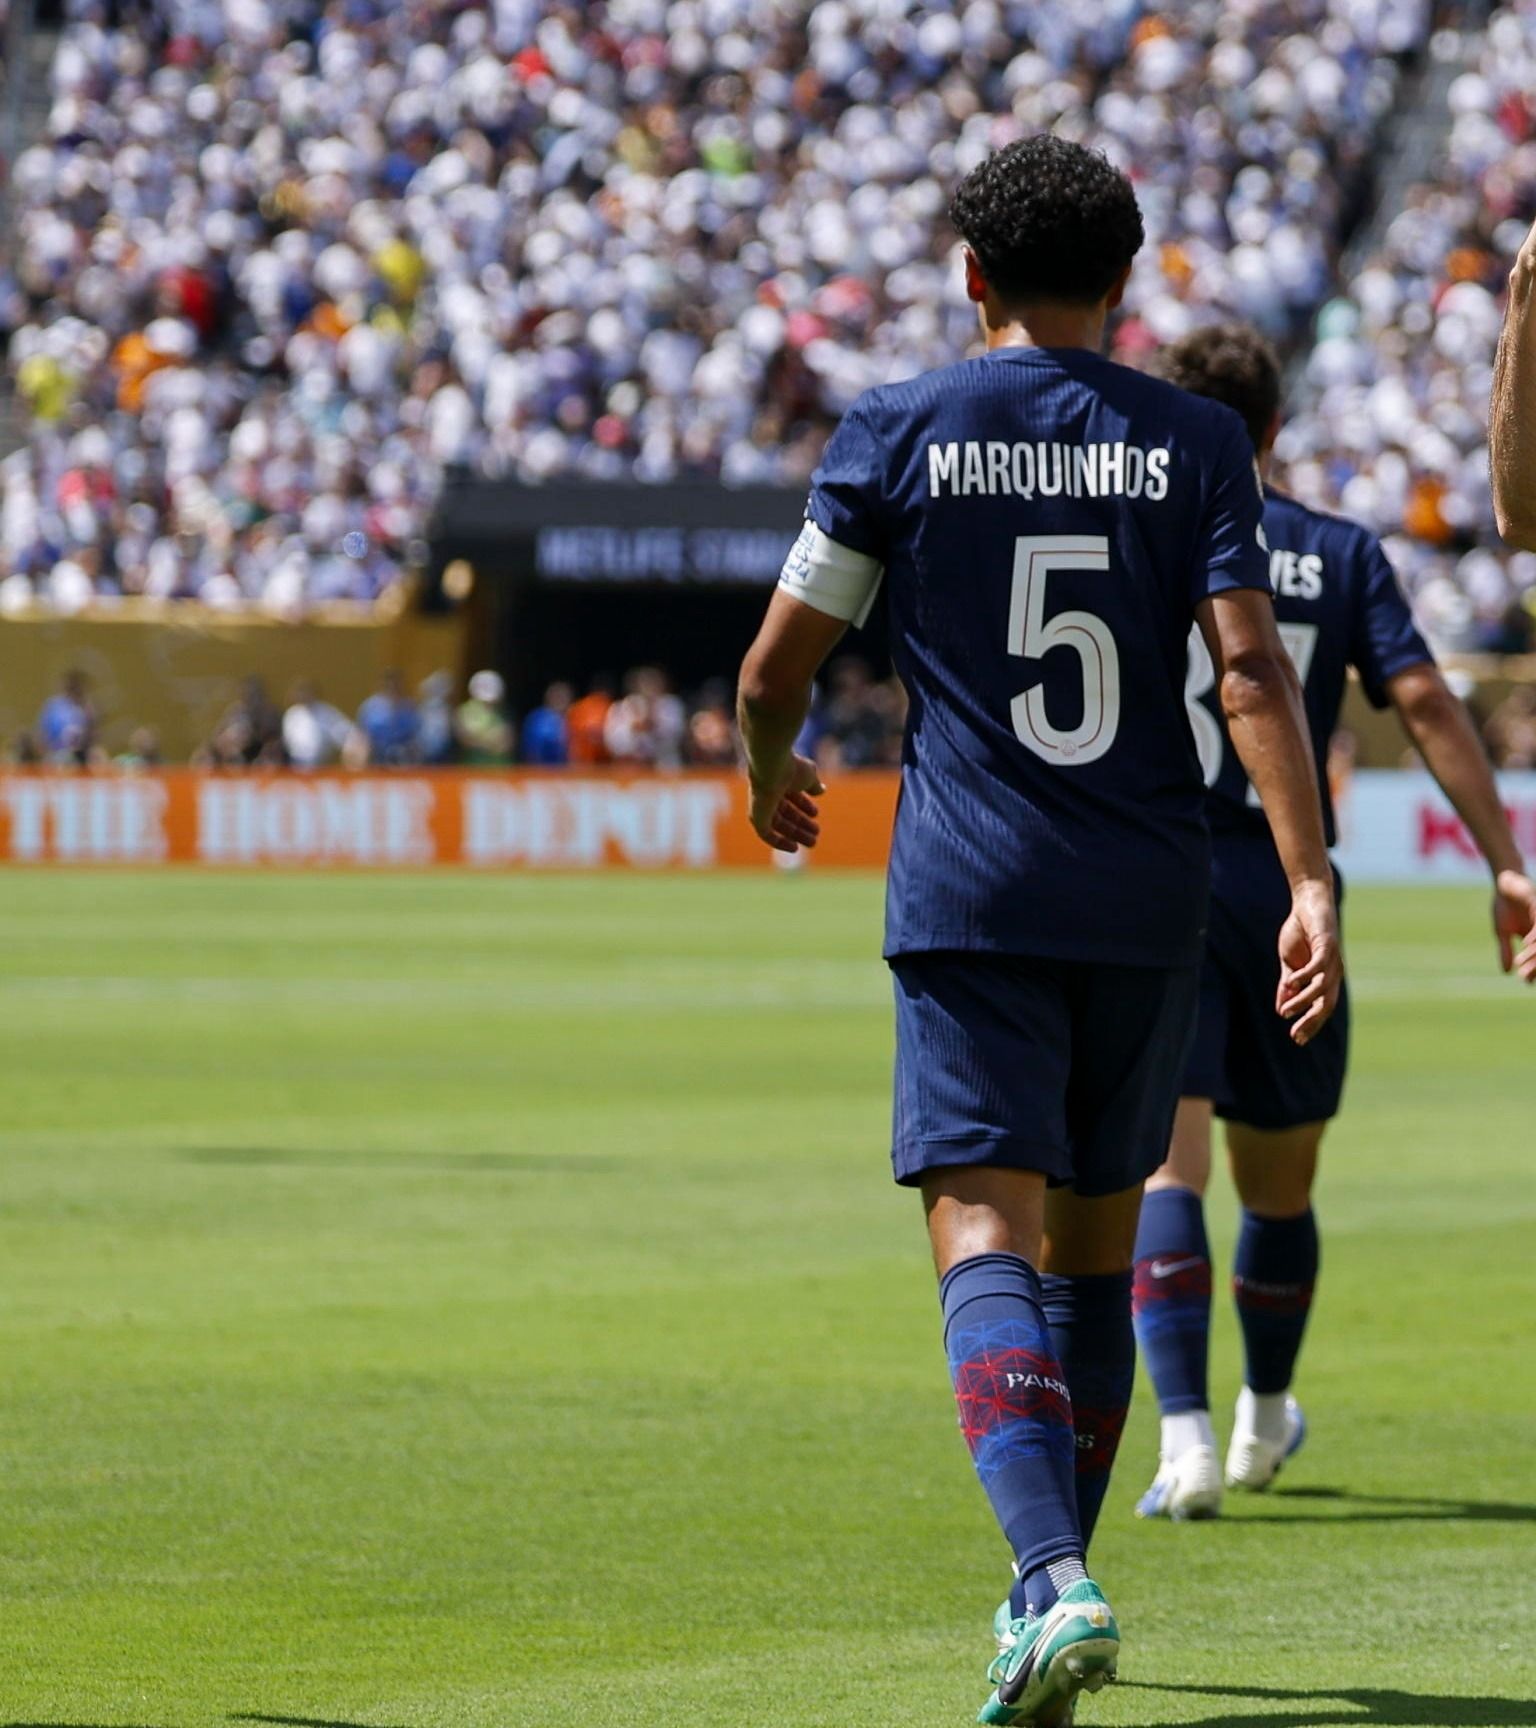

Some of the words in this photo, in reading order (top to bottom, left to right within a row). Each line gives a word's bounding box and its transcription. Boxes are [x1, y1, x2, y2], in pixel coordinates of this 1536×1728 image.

[928, 441, 1169, 500] MARQUINHOS
[1007, 534, 1121, 767] 5
[200, 778, 434, 866] HOME
[462, 778, 730, 868] DEPOT
